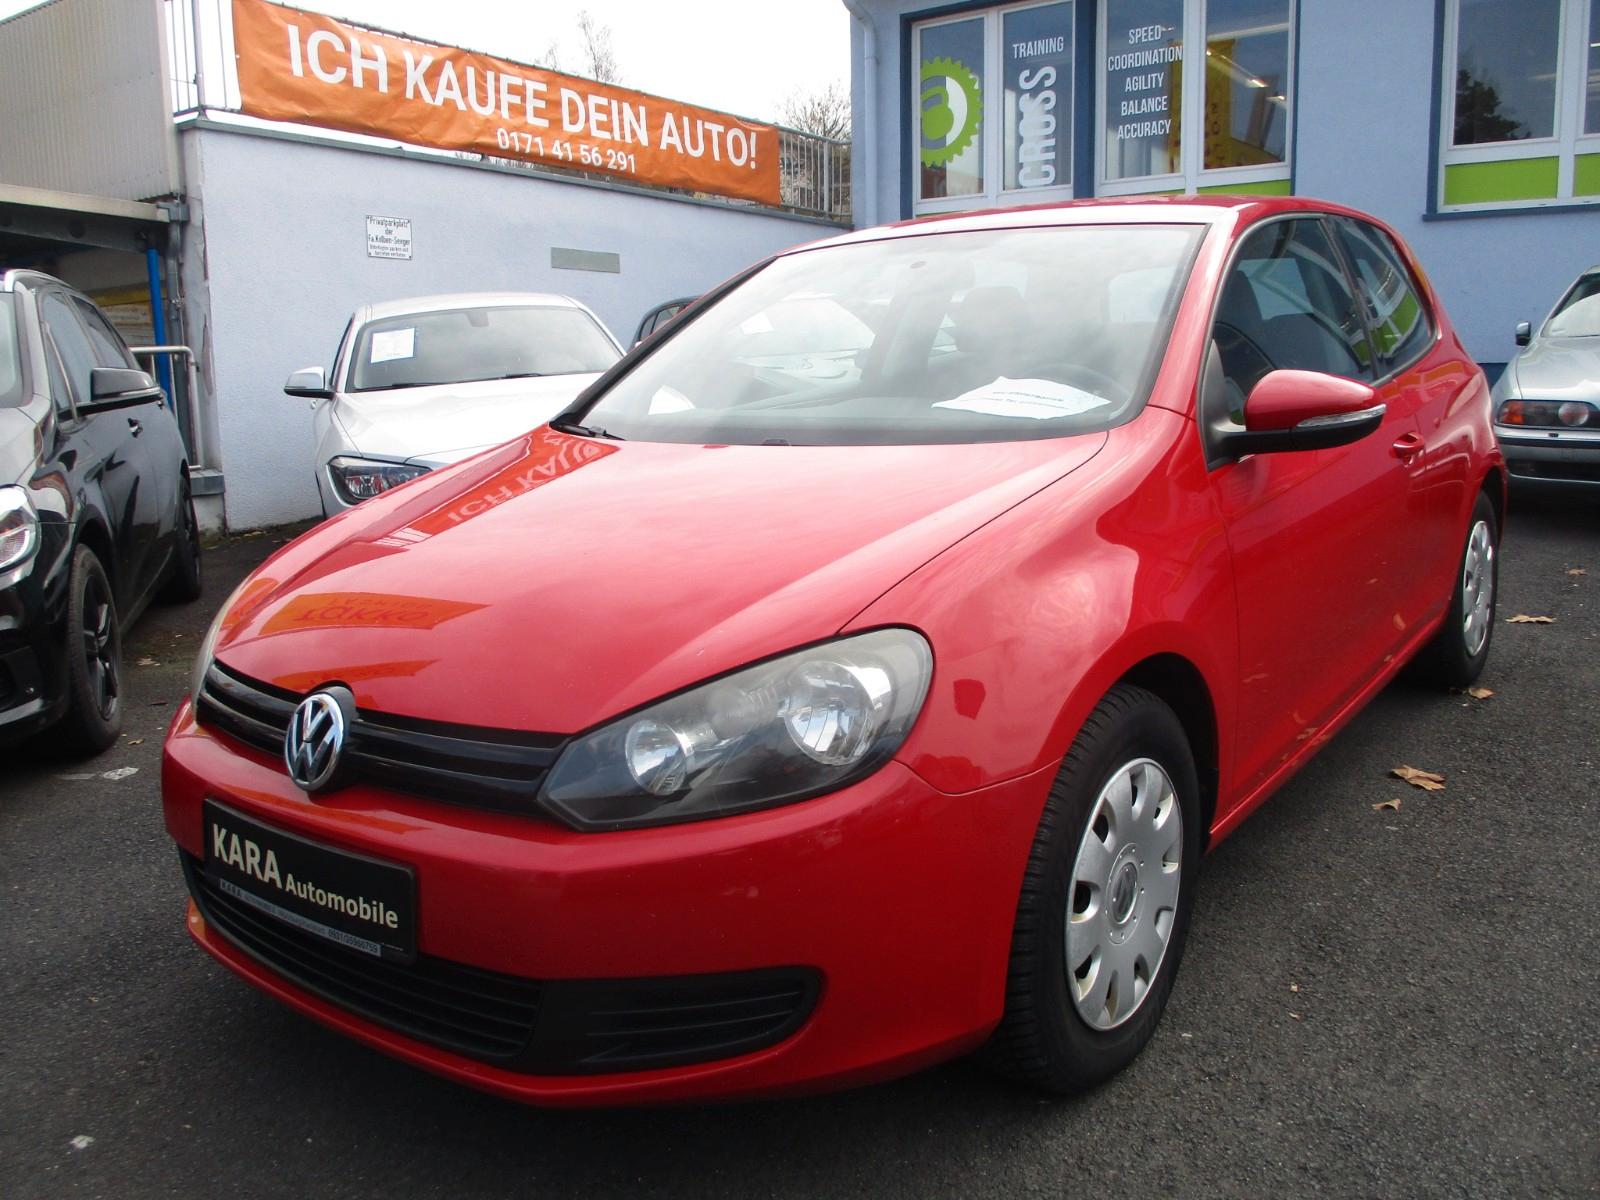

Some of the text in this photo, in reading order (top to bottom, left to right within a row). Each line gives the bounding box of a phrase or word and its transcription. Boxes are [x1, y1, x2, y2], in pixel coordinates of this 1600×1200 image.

[1128, 25, 1161, 44] SPEED
[1012, 36, 1064, 59] TRAINING
[1108, 45, 1184, 71] COORDINATION
[1125, 72, 1165, 92] AGILITY
[288, 24, 757, 169] ICH KAUFE DEIN AUTO!
[1121, 96, 1168, 116] BALANCE
[1018, 66, 1057, 187] CROSS
[1117, 119, 1172, 139] ACCURACY
[496, 127, 637, 174] 0171 41 56 291
[213, 823, 282, 889] KARA
[285, 872, 398, 929] Automobile
